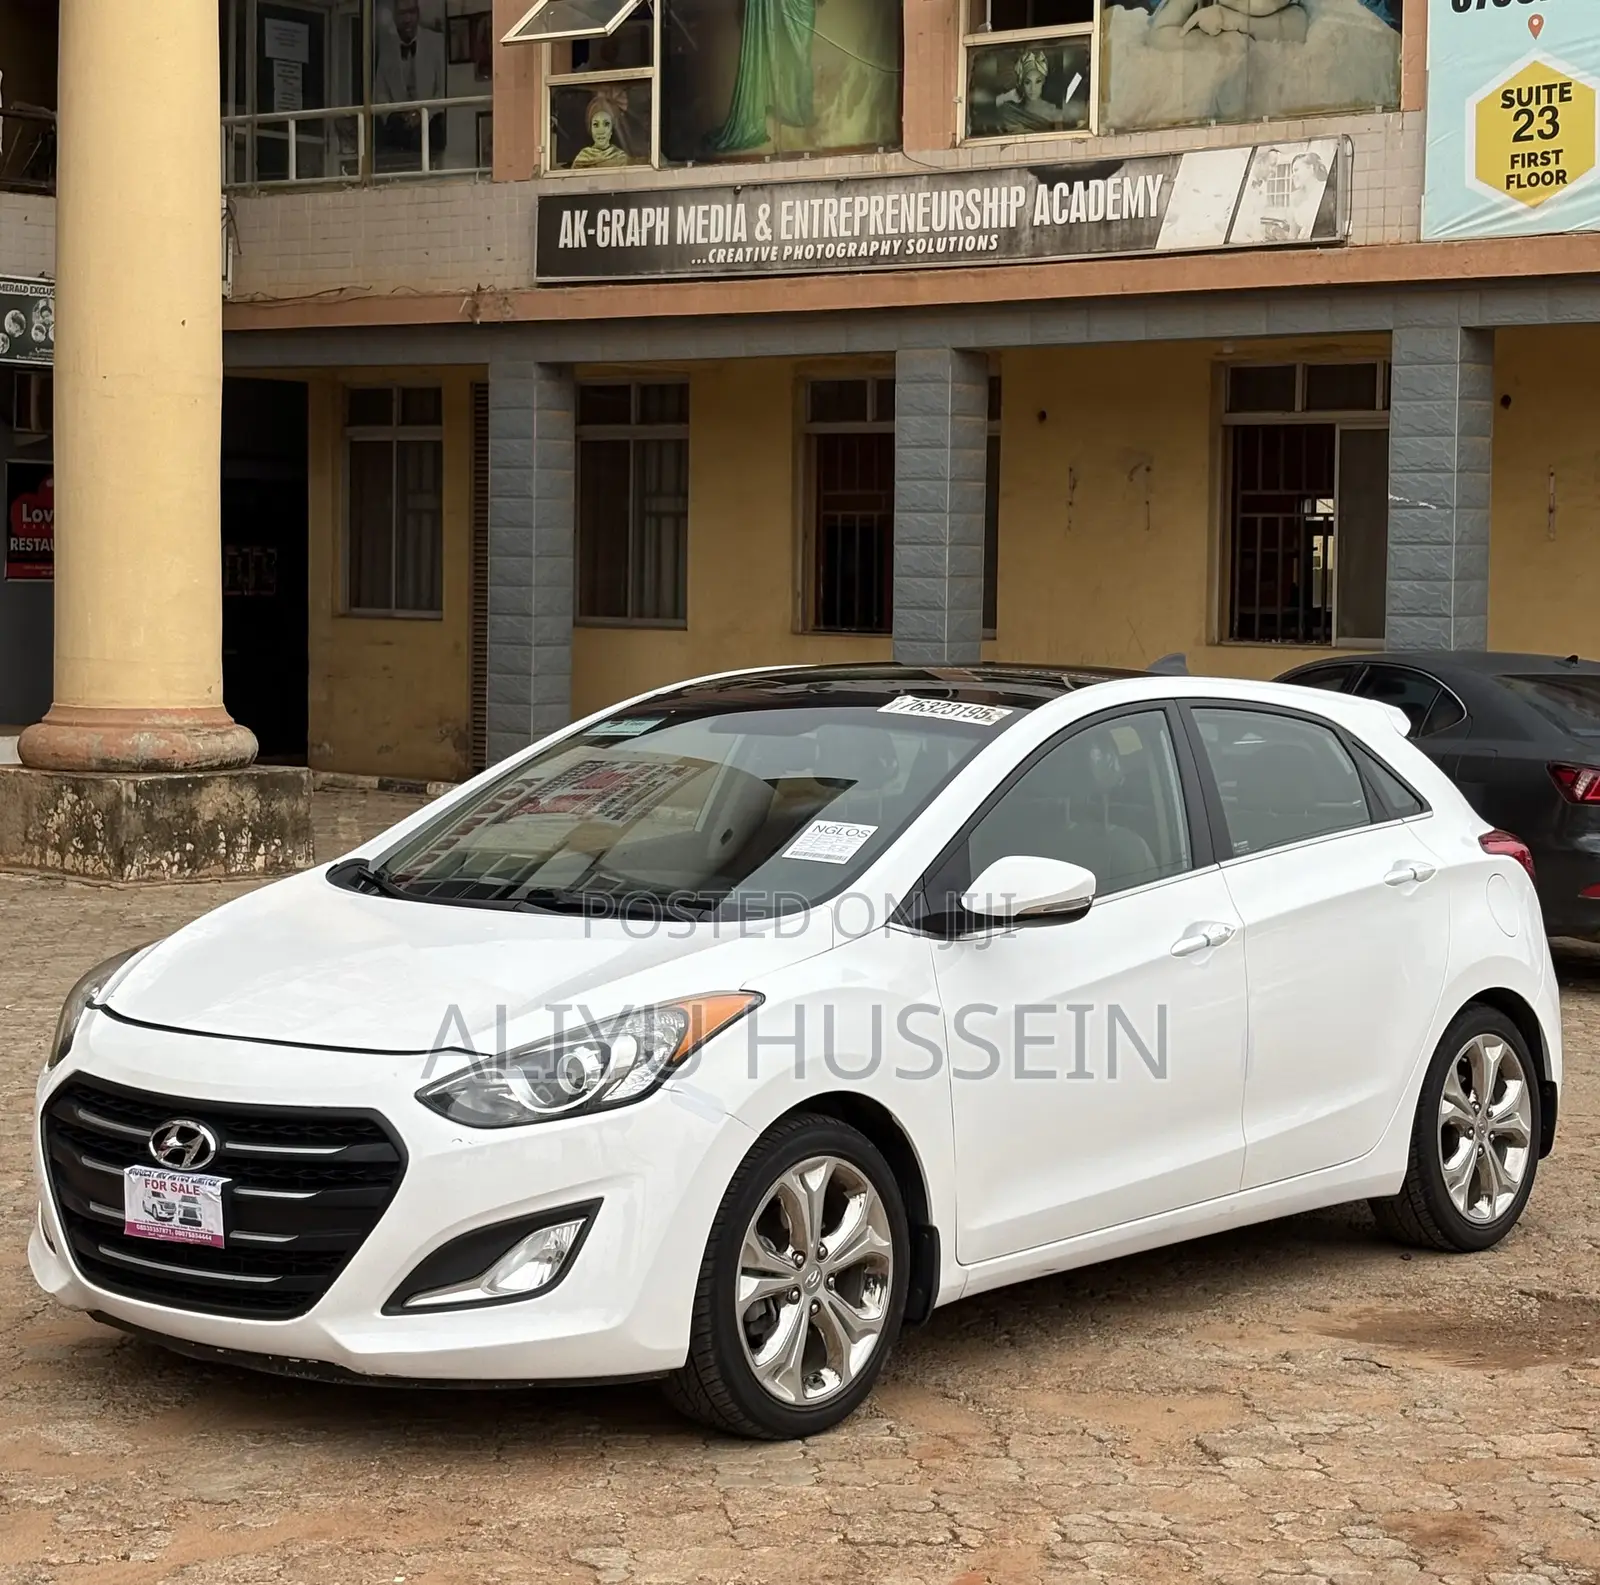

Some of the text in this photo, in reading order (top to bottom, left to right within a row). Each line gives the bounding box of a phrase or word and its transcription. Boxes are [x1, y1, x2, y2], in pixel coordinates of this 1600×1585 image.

[1500, 82, 1573, 109] SUITE
[1512, 106, 1561, 143] 23
[1510, 149, 1564, 170] FIRST
[1505, 169, 1568, 190] FLOOR
[558, 174, 1164, 249] AK-GRAPH MEDIA & ENTREPRENEURSHIP ACADEMY
[782, 239, 902, 261] PHOTOGRAPHY
[905, 234, 999, 255] SOLUTIONS
[812, 825, 871, 838] NGLOS
[144, 1179, 201, 1196] FOR SALE
